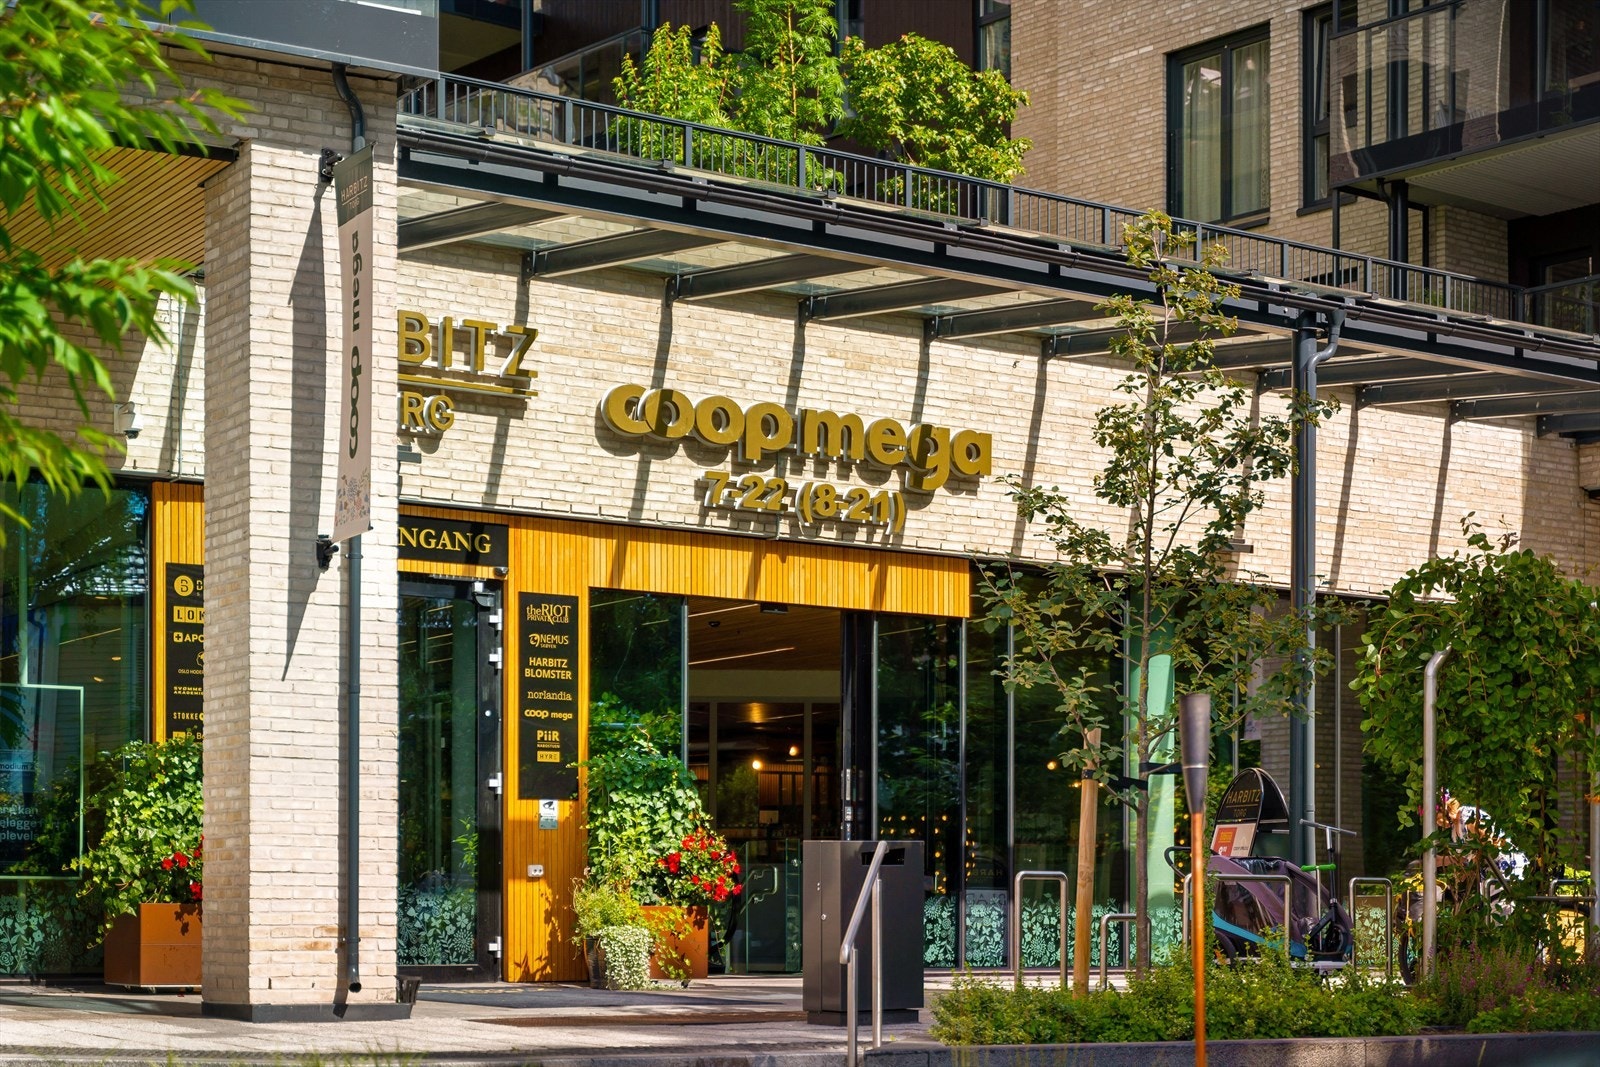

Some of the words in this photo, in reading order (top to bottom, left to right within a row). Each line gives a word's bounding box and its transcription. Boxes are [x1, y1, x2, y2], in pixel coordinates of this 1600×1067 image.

[341, 176, 368, 202] HARBITZ
[352, 230, 363, 333] mega
[397, 310, 539, 379] BITZ
[349, 345, 362, 459] coop
[601, 383, 793, 463] coop
[799, 408, 993, 492] mega
[704, 470, 789, 512] 7-22
[797, 480, 905, 535] (8-21)
[398, 527, 492, 554] NGANG
[526, 614, 551, 622] PRIVATE
[540, 634, 569, 645] NEMUS
[529, 656, 568, 668] HARBITZ
[524, 668, 572, 680] BLOMSTER
[527, 690, 573, 701] norlandia
[524, 709, 549, 719] coop
[550, 712, 573, 721] mega
[537, 729, 560, 742] PiiR
[1226, 789, 1261, 803] HARBITZ
